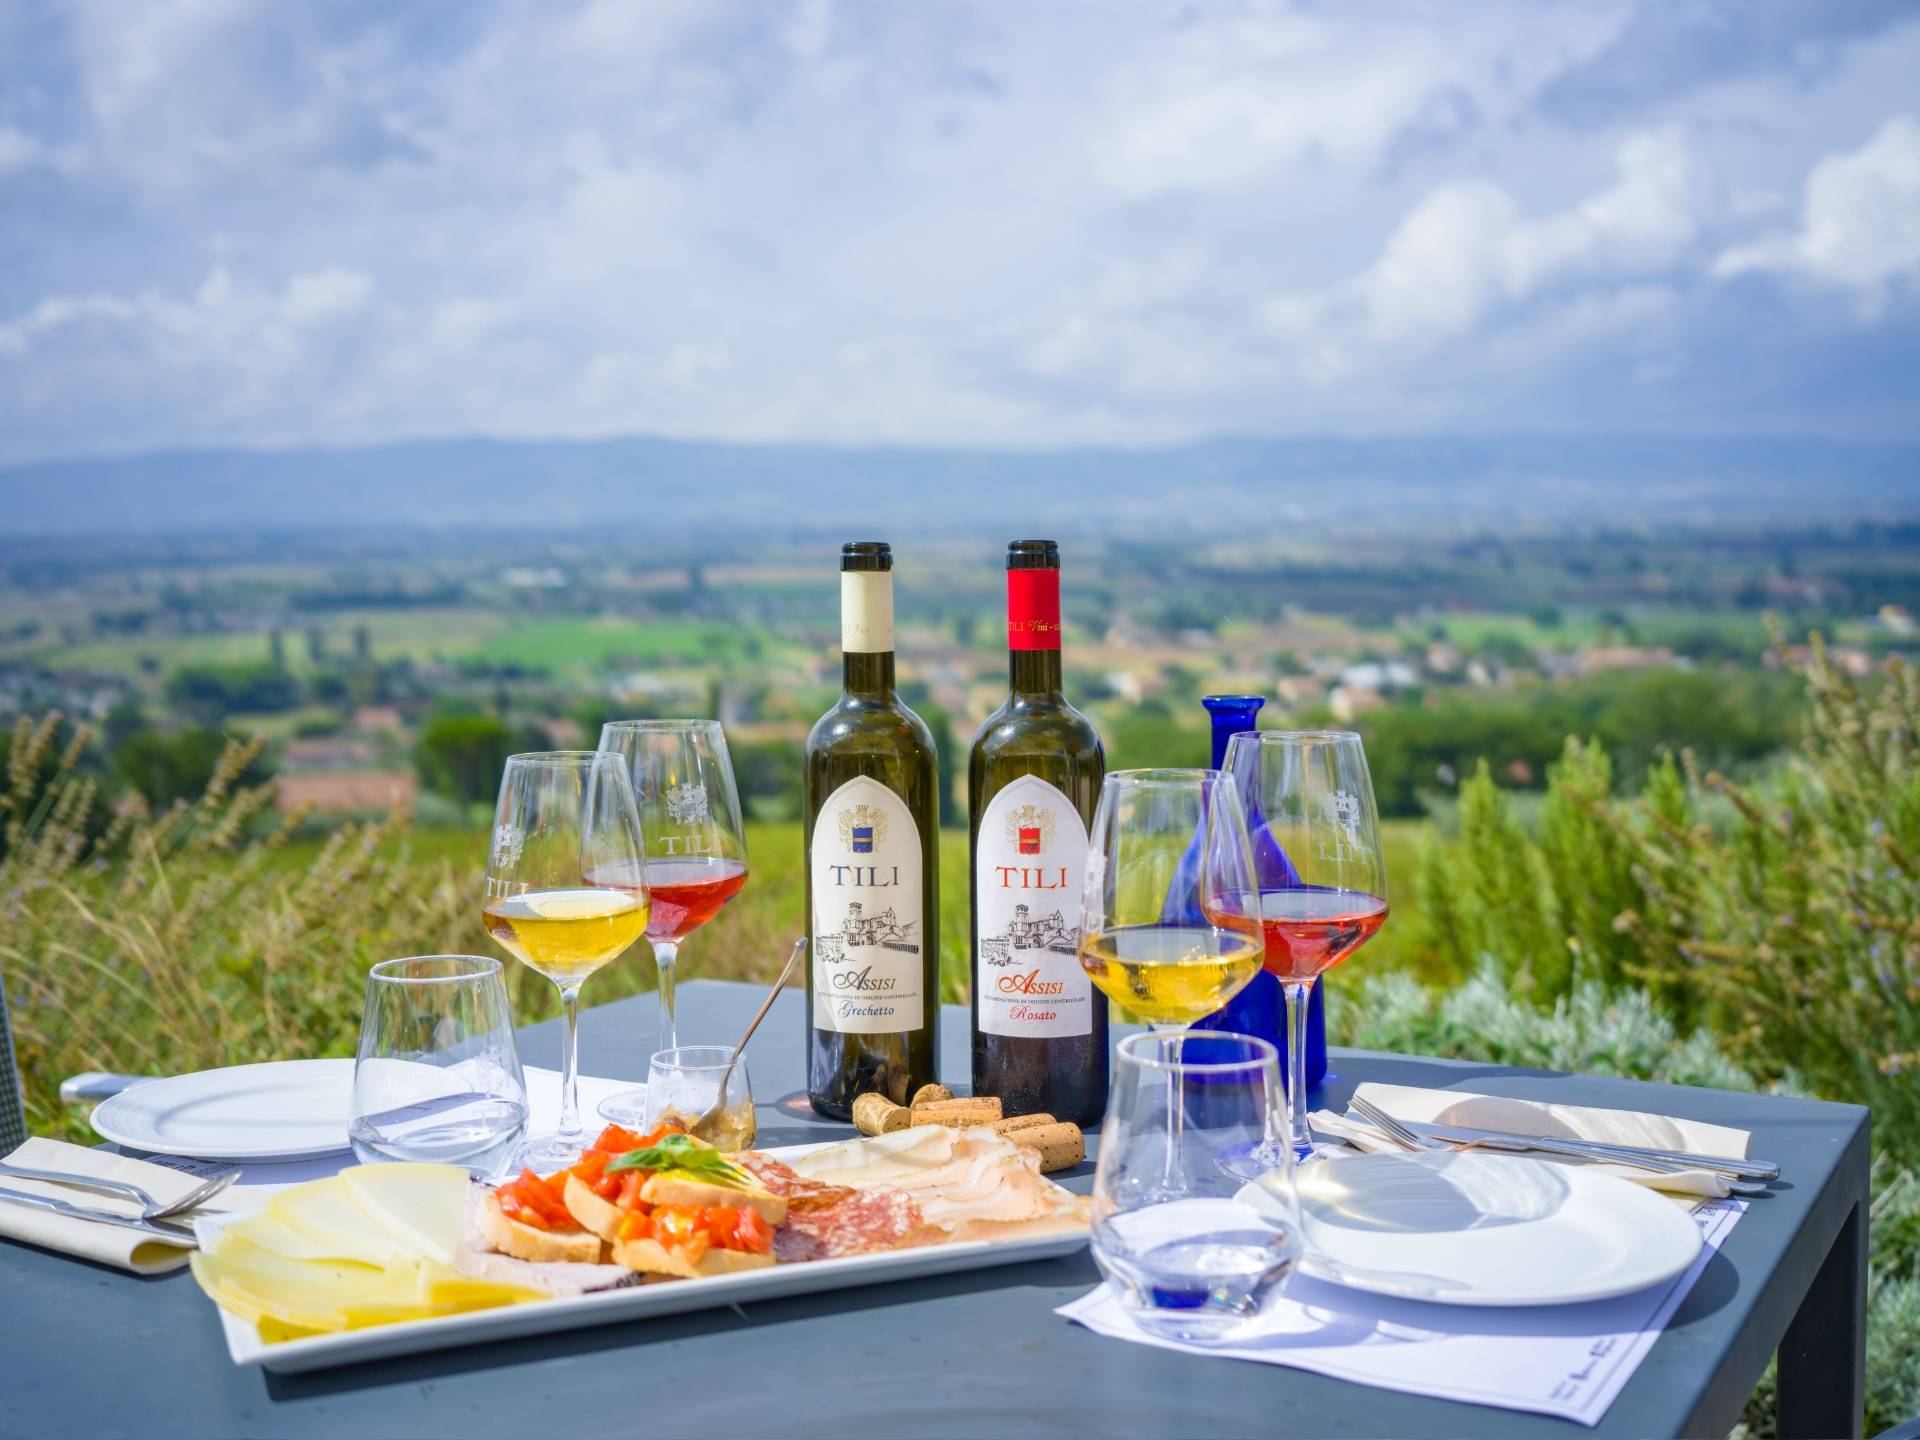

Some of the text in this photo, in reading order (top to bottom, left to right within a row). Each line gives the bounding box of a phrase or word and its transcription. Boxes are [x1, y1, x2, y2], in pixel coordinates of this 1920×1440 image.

[829, 865, 899, 887] TILI
[996, 866, 1068, 889] TILI
[838, 1000, 895, 1018] Grechetto
[1009, 1005, 1056, 1020] Rosato
